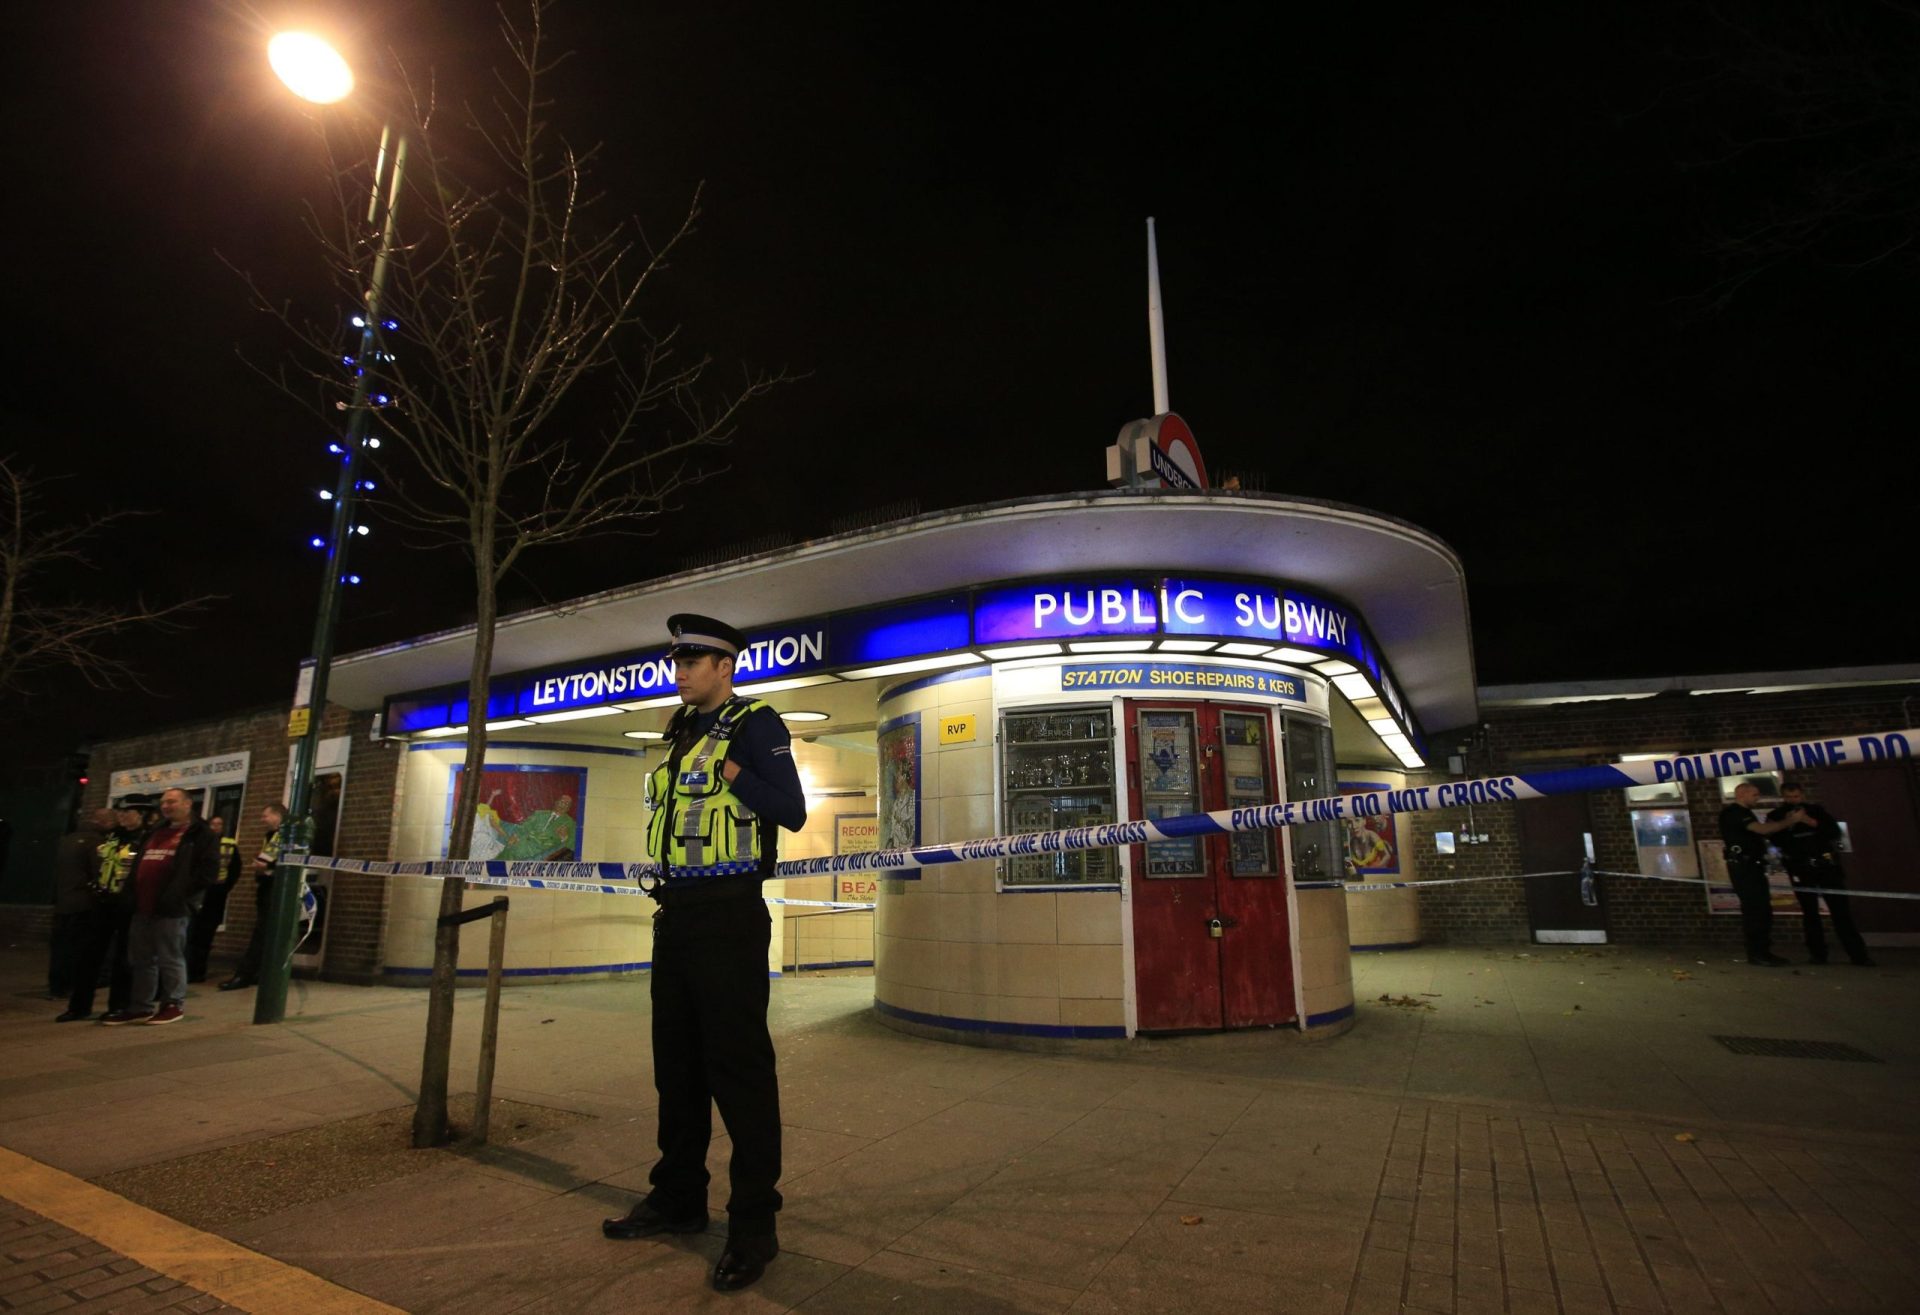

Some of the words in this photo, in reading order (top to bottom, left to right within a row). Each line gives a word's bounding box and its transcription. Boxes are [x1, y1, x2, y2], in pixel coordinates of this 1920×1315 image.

[1034, 589, 1205, 628] PUBLIC
[1235, 593, 1346, 646] SUBWAY
[533, 659, 676, 706] LEYTONSTON
[734, 631, 823, 674] ATION
[1063, 669, 1142, 686] STATION
[1258, 677, 1266, 690] &
[1269, 679, 1295, 695] KEYS
[948, 723, 966, 735] RVP
[1653, 750, 1762, 784] POLICE
[1772, 740, 1848, 770] LINE
[1859, 733, 1911, 762] DO
[1231, 803, 1298, 831] POLICE
[1302, 798, 1346, 823] LINE
[1351, 794, 1381, 818] DO
[1388, 786, 1430, 814] NOT
[1438, 778, 1518, 809] CROSS
[961, 838, 1006, 860] POLICE
[1008, 833, 1040, 856] LINE
[1040, 831, 1060, 852] DO
[1064, 827, 1094, 850] NOT
[1096, 821, 1148, 846] CROSS
[509, 862, 533, 877] POLICE
[532, 862, 548, 876] LINE
[546, 862, 558, 877] DO
[556, 862, 573, 877] NOT
[571, 862, 596, 878] CROSS
[776, 861, 807, 876] POLICE
[810, 856, 833, 874] LINE
[832, 854, 848, 871] DO
[848, 851, 872, 870] NOT
[870, 848, 905, 868] CROSS
[1151, 861, 1193, 873] LACES
